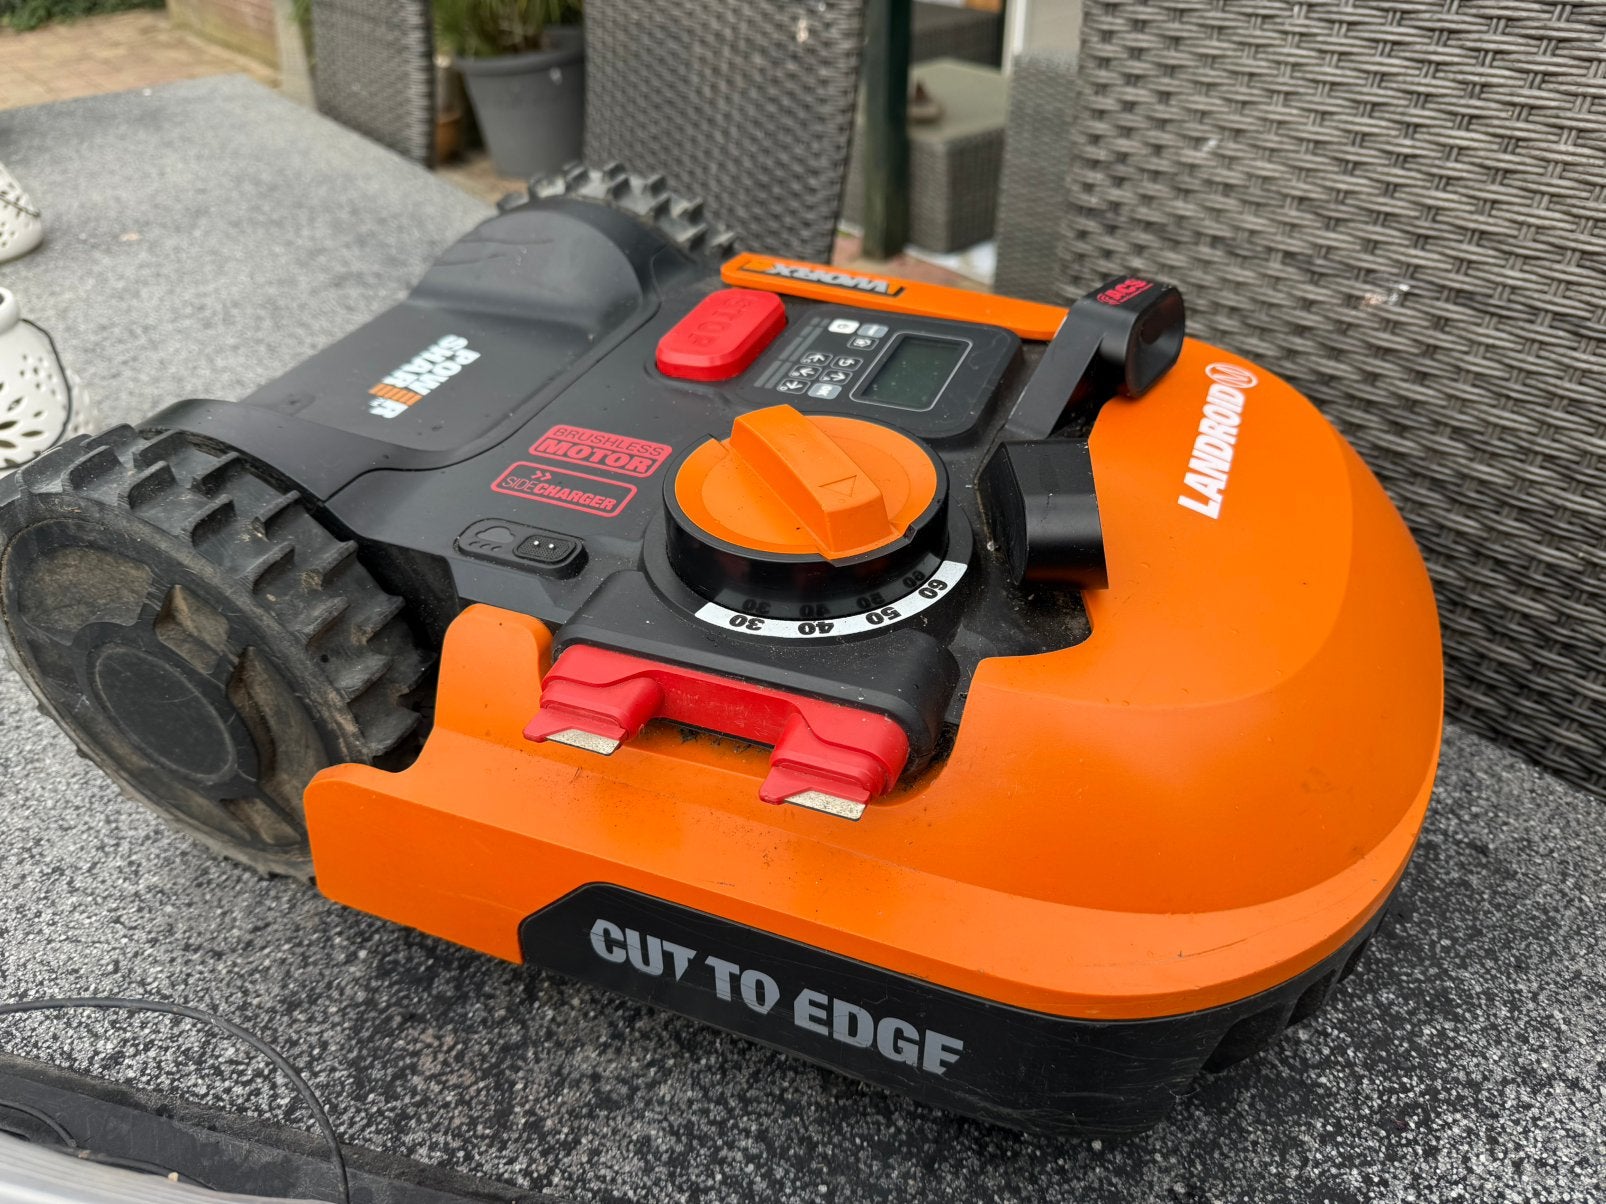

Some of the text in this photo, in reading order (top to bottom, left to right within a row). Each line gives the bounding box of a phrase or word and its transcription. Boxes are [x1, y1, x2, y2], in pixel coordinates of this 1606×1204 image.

[768, 262, 889, 293] WORX
[1105, 278, 1148, 301] ACS
[687, 296, 754, 348] STOP
[536, 438, 653, 474] MOTOR
[552, 427, 665, 457] BRUSHLESS
[1177, 383, 1246, 520] LANDROID
[918, 579, 948, 600] 60
[729, 614, 766, 631] 30
[797, 621, 835, 636] 40
[865, 606, 903, 625] 50
[589, 918, 964, 1076] CUT TO EDGE
